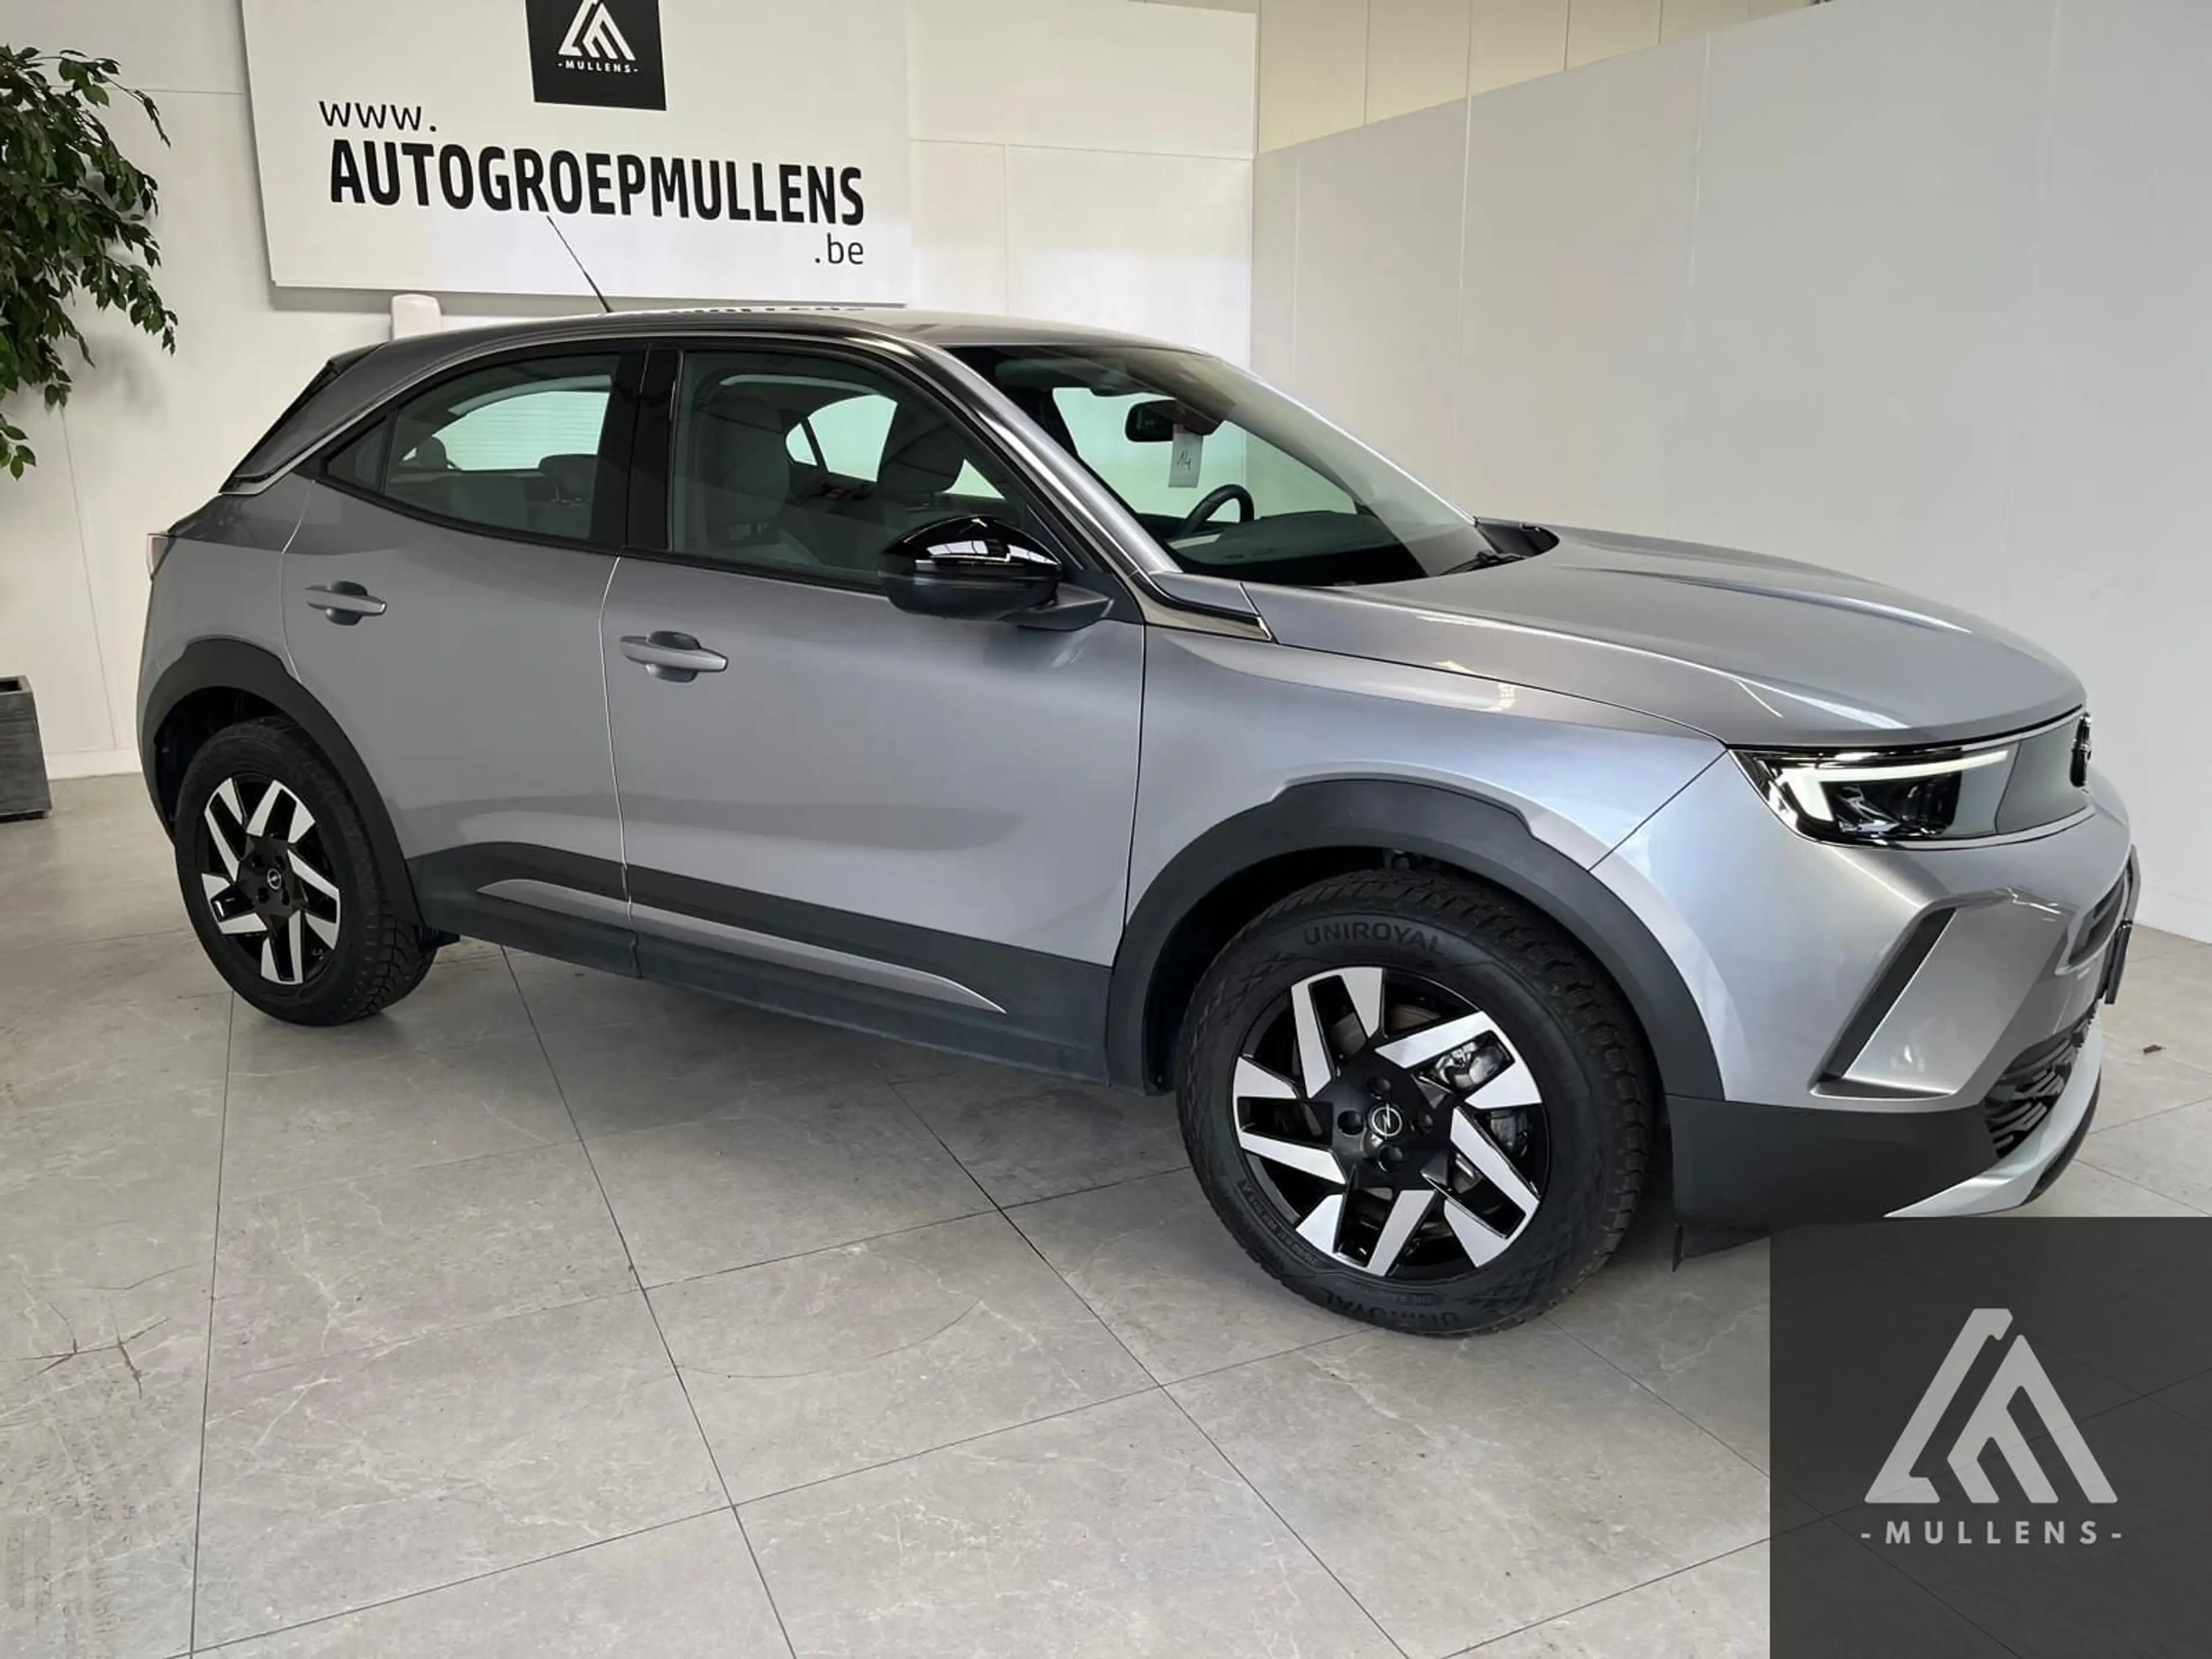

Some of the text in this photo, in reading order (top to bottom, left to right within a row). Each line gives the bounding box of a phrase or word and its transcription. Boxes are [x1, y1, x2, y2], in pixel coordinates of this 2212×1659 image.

[319, 100, 437, 132] www.
[330, 138, 863, 226] AUTOGROEPMULLENS
[815, 232, 863, 265] .be
[1303, 922, 1444, 956] UNIROYAL
